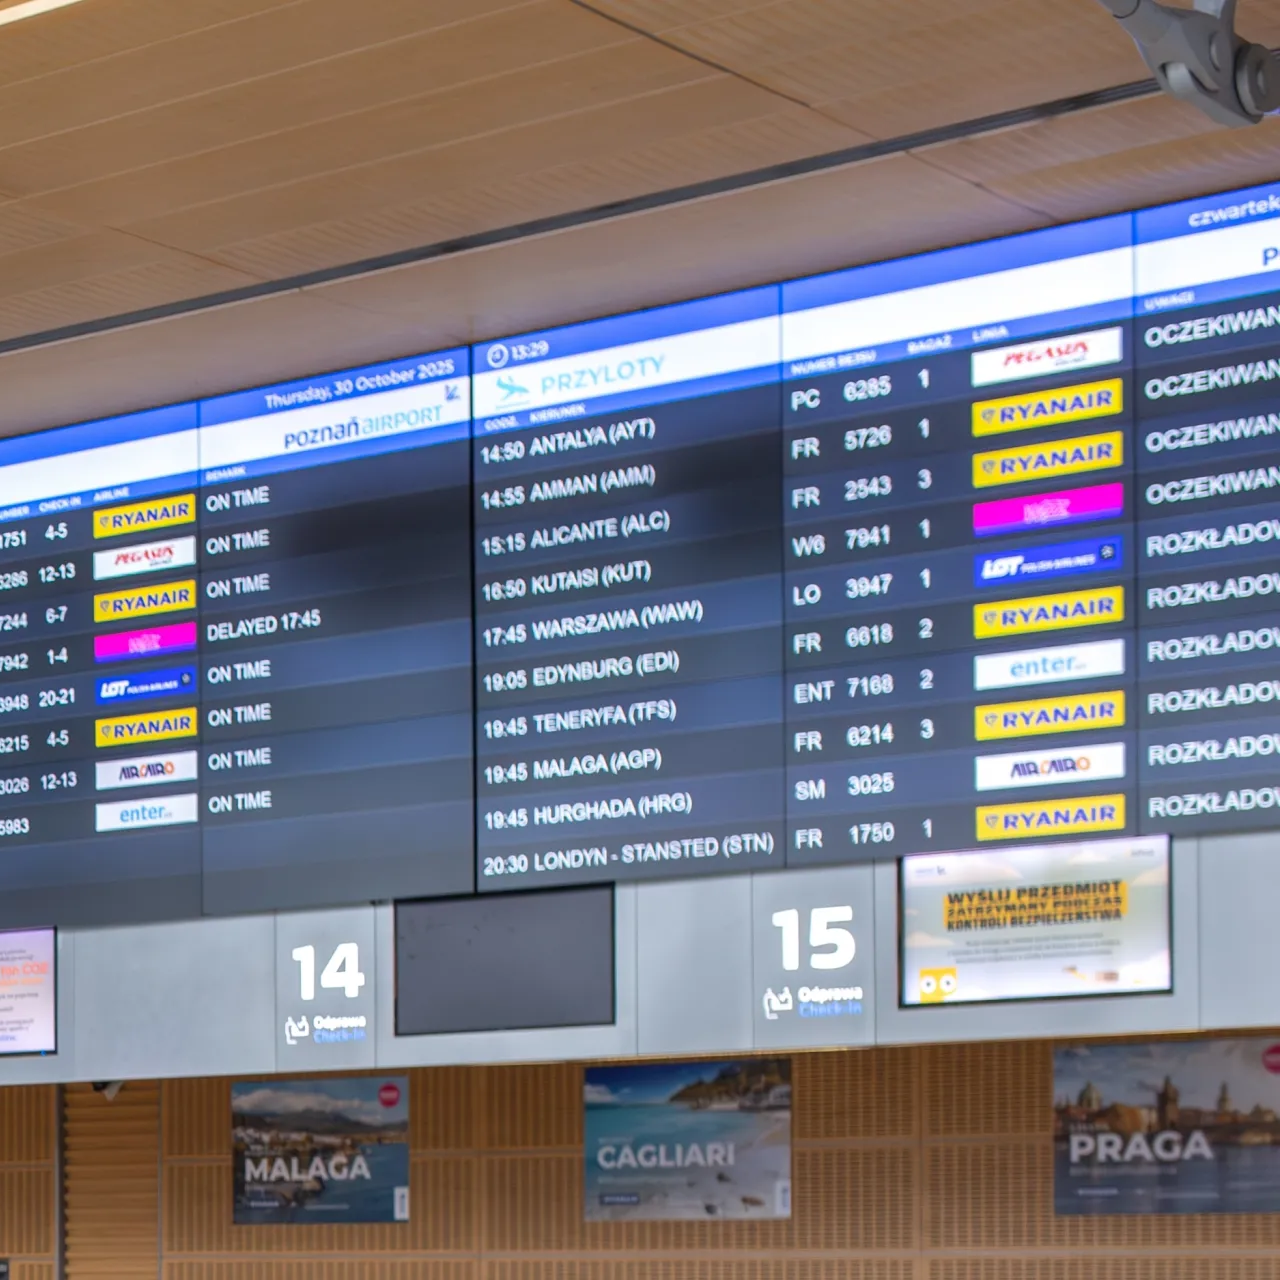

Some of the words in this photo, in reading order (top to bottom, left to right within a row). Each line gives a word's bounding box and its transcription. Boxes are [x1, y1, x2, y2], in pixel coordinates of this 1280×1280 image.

[355, 368, 415, 393] October
[542, 355, 665, 395] PRZYLOTY
[206, 493, 229, 512] ON
[232, 486, 270, 506] TIME
[482, 487, 525, 509] 14:55
[530, 473, 597, 502] AMMAN
[601, 465, 655, 493] (AMM)
[112, 503, 189, 530] RYANAIR
[45, 522, 68, 541] 4-5
[483, 533, 525, 555] 15:15
[531, 518, 618, 549] ALICANTE
[622, 511, 670, 538] (ALC)
[39, 563, 76, 583] 12-13
[46, 606, 68, 623] 6-7
[207, 614, 278, 642] DELAYED
[280, 610, 321, 629] 17:45
[483, 624, 527, 647] 17:45
[532, 609, 639, 642] WARSZAWA
[641, 600, 703, 628] (WAW)
[47, 647, 68, 665] 1-4
[483, 670, 527, 693] 19:05
[534, 656, 633, 687] EDYNBURG
[637, 651, 679, 677] (EDI)
[39, 688, 75, 708] 20-21
[101, 681, 129, 698] LOT
[114, 715, 190, 738] RYANAIR
[484, 716, 528, 738] 19:45
[534, 704, 627, 734] TENERYFA
[630, 698, 677, 724] (TFS)
[772, 906, 856, 971] 15
[292, 943, 365, 1000] 14
[598, 1143, 735, 1169] CAGLIARI
[1069, 1132, 1214, 1163] PRAGA
[245, 1155, 371, 1182] MALAGA
